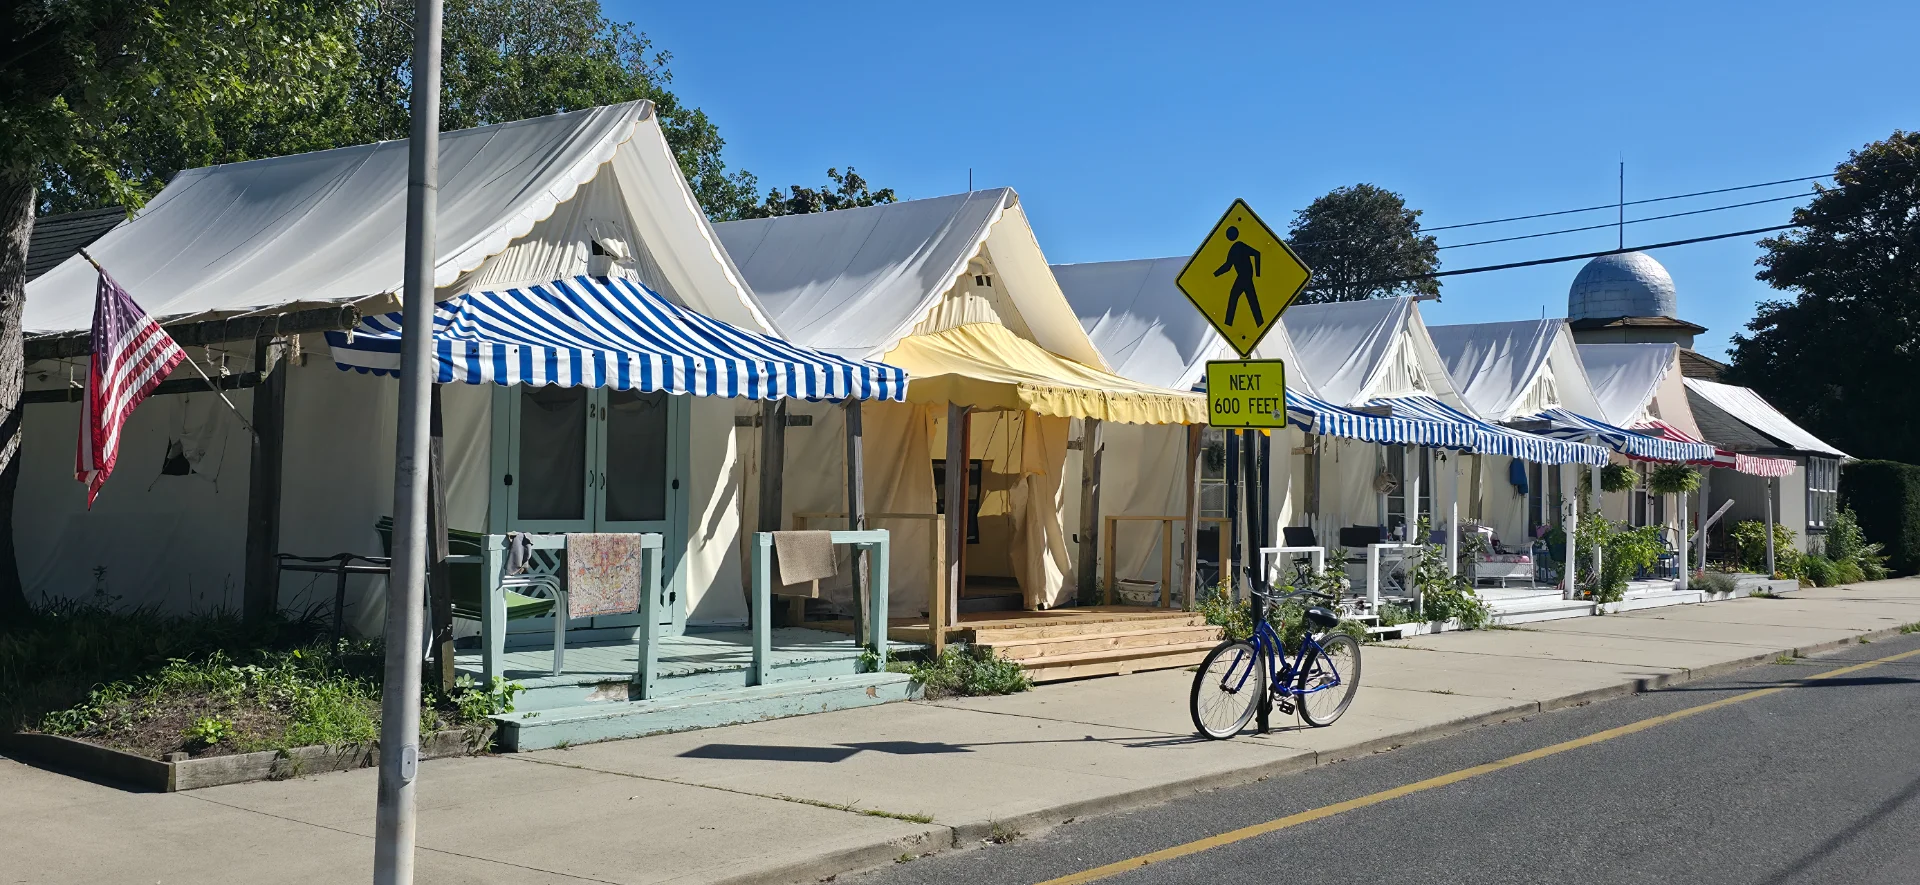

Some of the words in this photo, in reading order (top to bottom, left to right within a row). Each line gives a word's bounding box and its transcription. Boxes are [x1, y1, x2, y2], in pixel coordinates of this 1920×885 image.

[1229, 374, 1262, 391] NEXT
[590, 402, 606, 422] 20
[1214, 397, 1240, 414] 600
[1248, 397, 1279, 414] FEET
